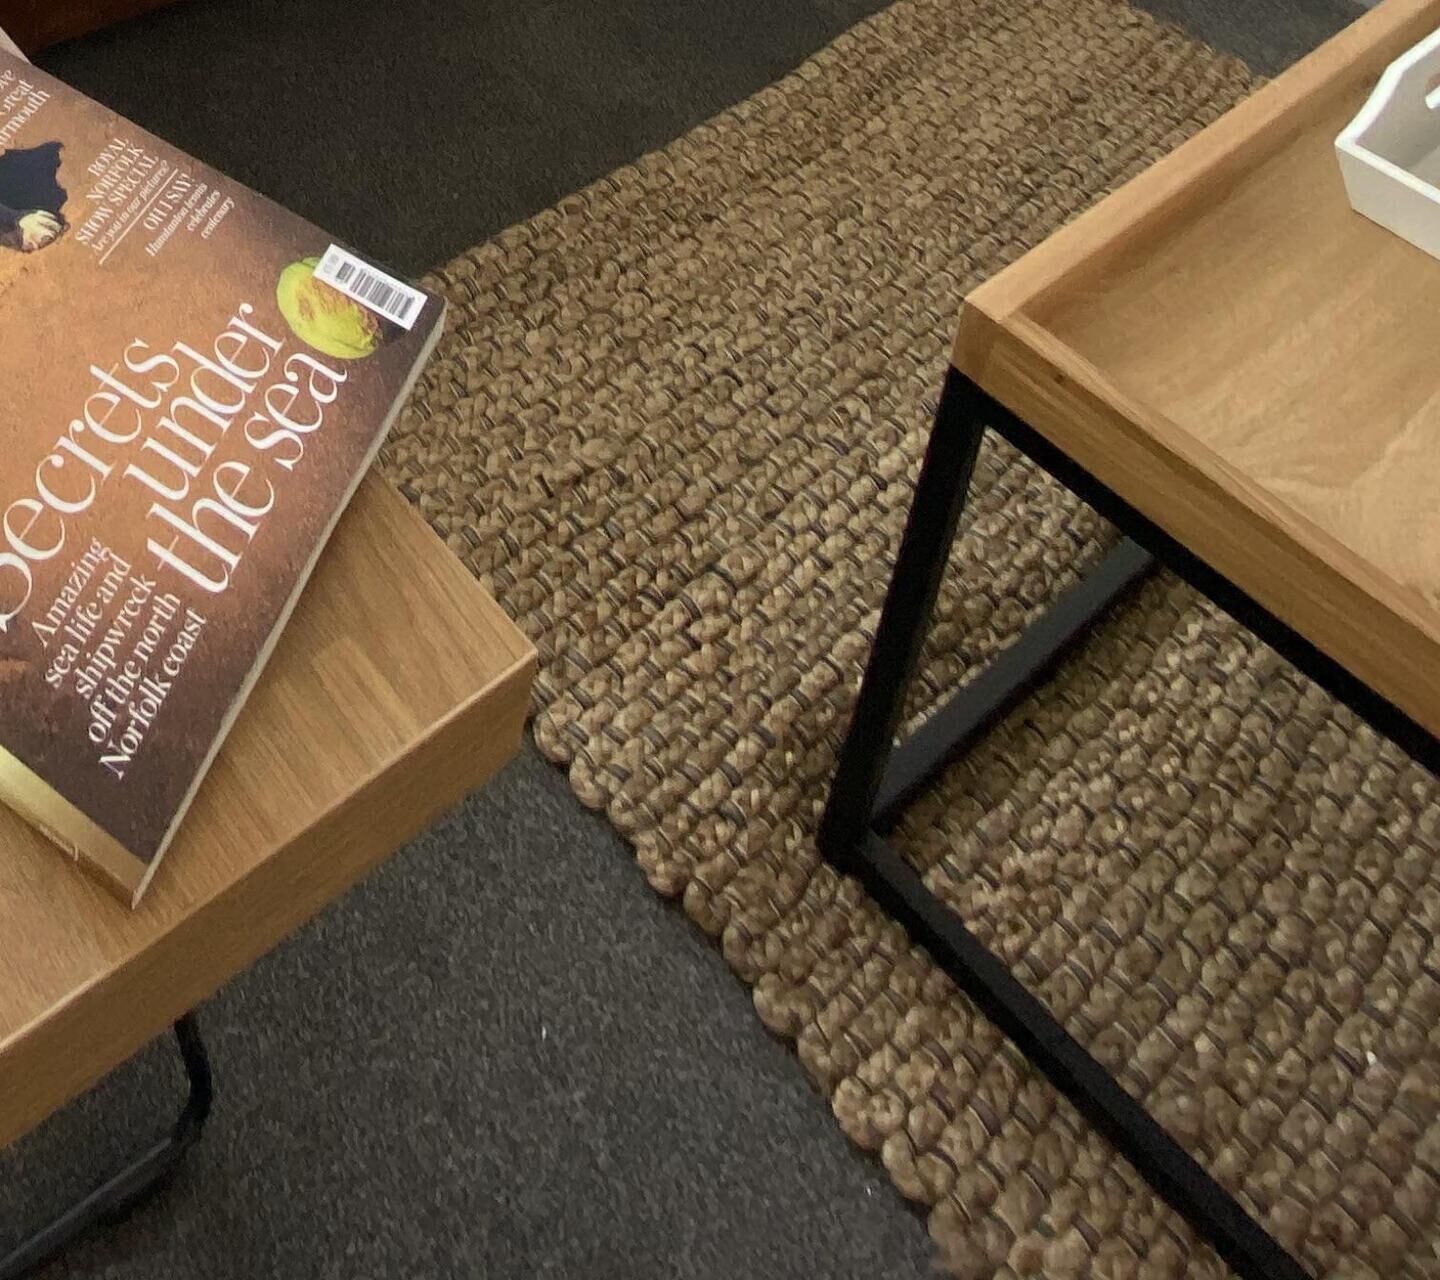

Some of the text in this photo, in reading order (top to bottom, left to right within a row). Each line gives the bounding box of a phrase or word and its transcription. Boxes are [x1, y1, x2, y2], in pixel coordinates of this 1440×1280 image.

[75, 154, 160, 246] SHOW SPECIAL
[86, 143, 145, 205] NORFOLK
[87, 137, 129, 177] ROYAL
[143, 206, 168, 231] OH
[166, 172, 196, 204] SAY!
[122, 302, 287, 502] under
[145, 352, 349, 594] the sea
[31, 536, 112, 648] Amazing
[45, 552, 132, 689] sea life and
[75, 573, 157, 700] shipwreck
[87, 592, 181, 744] off the north
[99, 607, 208, 780] Norfolk coast
